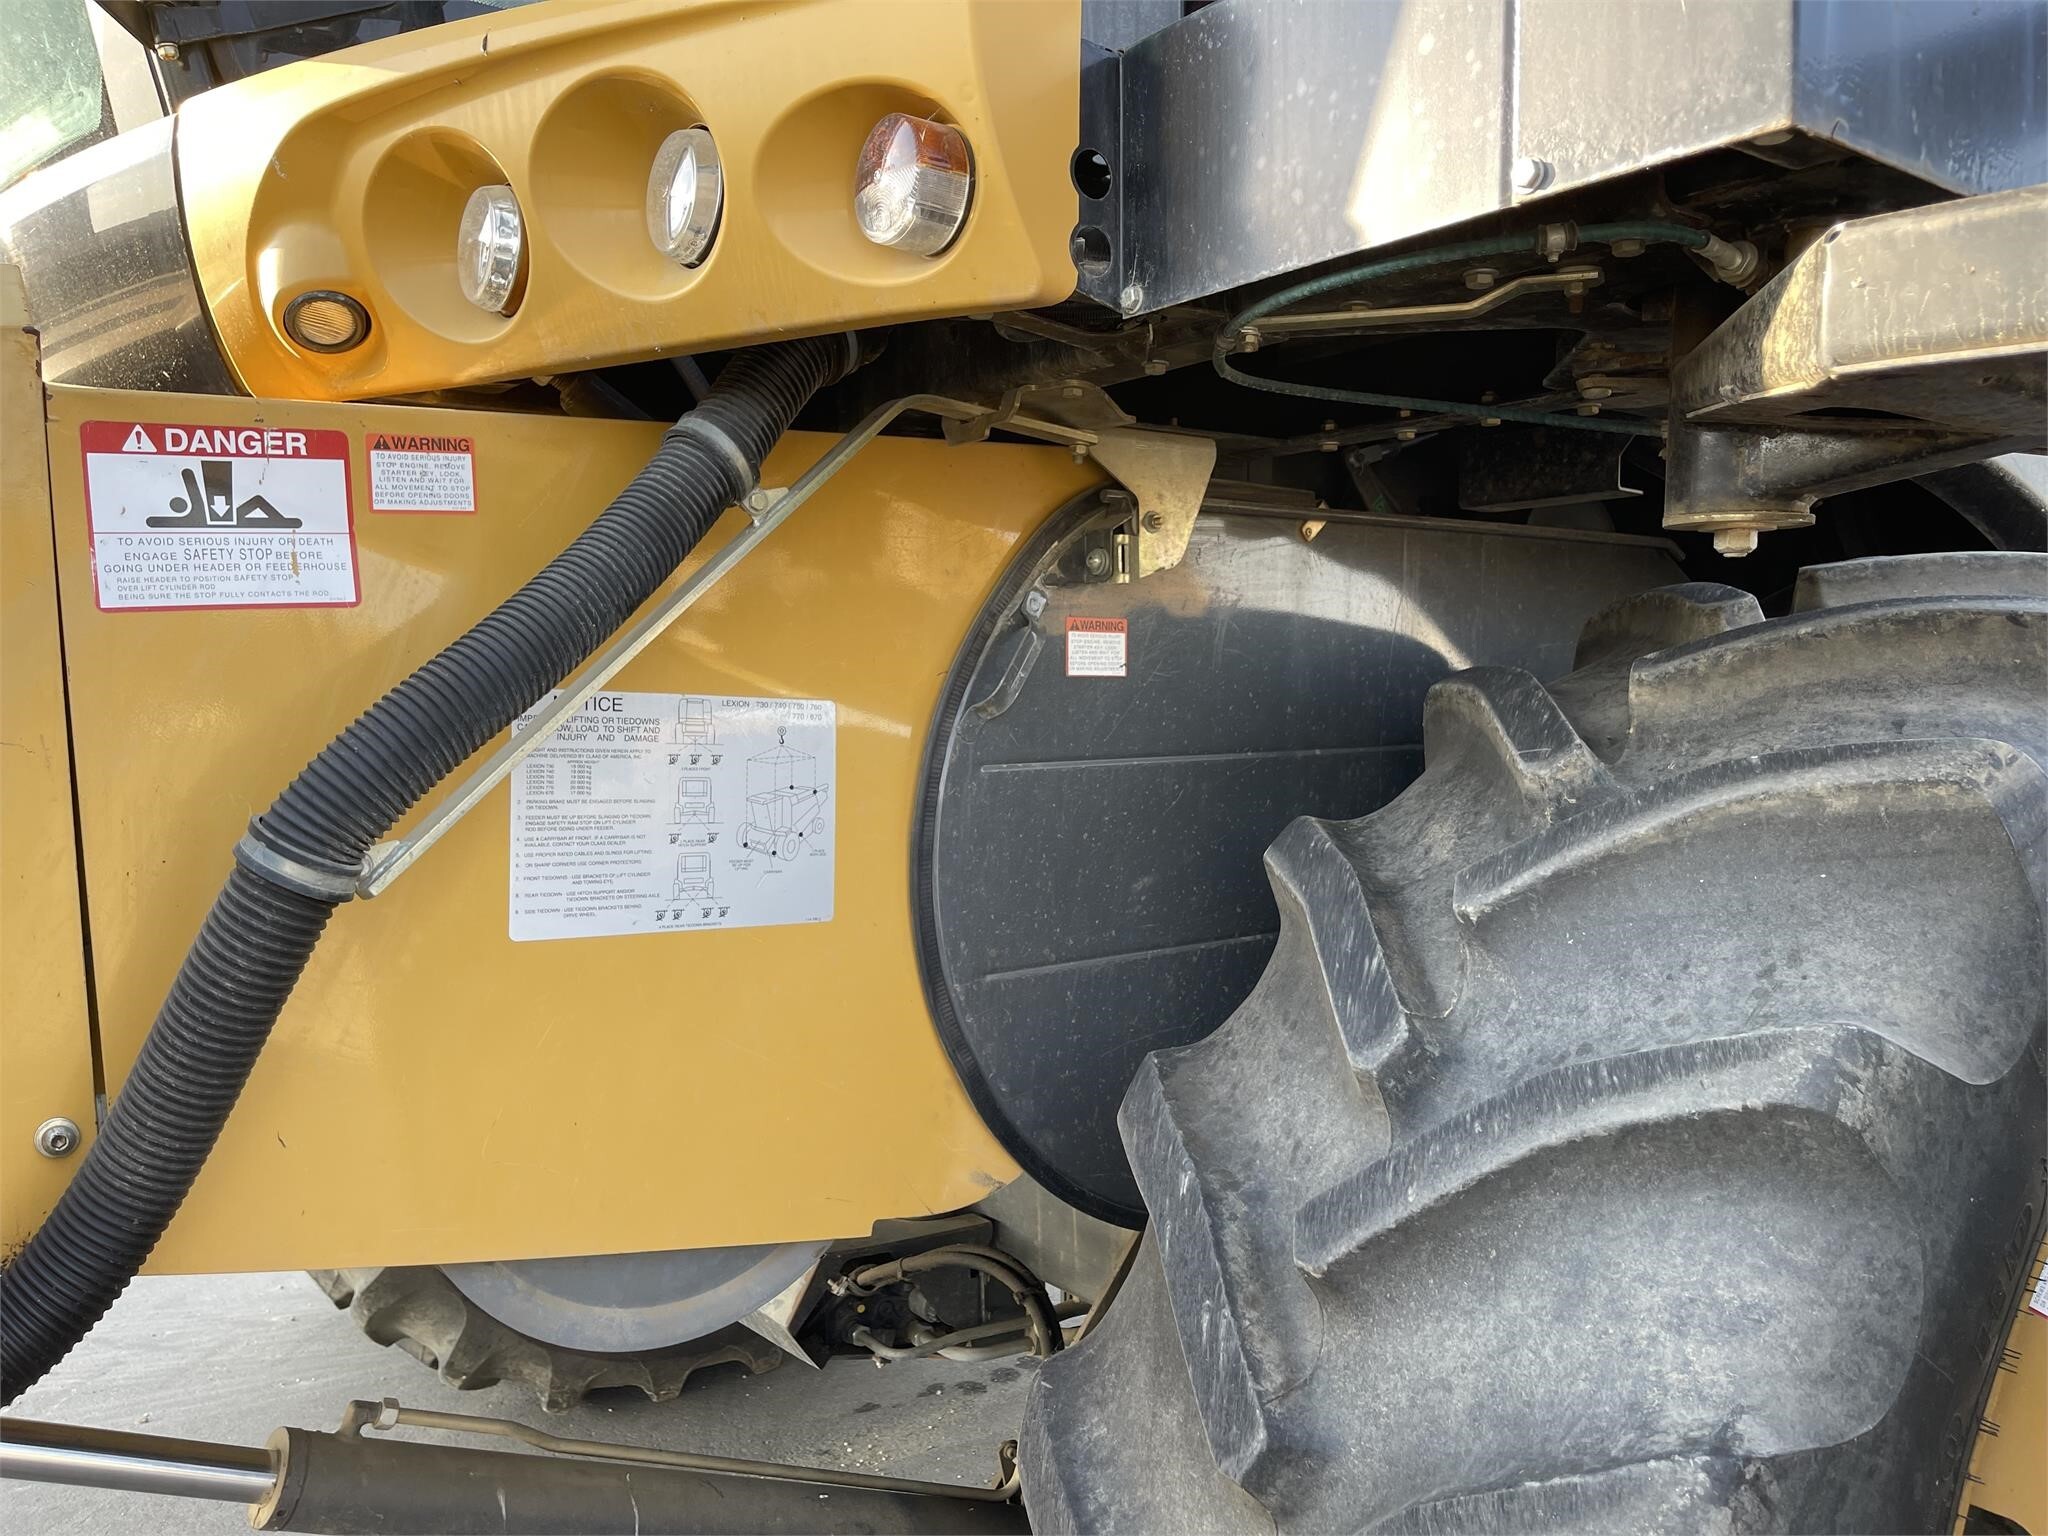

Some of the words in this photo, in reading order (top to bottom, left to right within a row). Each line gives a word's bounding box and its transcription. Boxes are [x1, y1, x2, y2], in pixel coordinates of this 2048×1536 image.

[165, 428, 307, 455] DANGER
[391, 436, 470, 452] WARNING
[376, 452, 386, 460] TO
[434, 462, 465, 470] REMOVE
[117, 537, 133, 546] TO
[138, 537, 174, 546] AVOID
[178, 537, 230, 546] SERIOUS
[234, 537, 274, 546] INJURY
[278, 537, 295, 546] OR
[298, 537, 334, 546] DEATH
[124, 552, 177, 561] ENGAGE
[184, 548, 234, 561] SAFETY
[239, 548, 273, 561] STOP
[275, 551, 322, 560] BEORE
[103, 564, 143, 573] GOING
[147, 564, 189, 573] UNDER
[193, 563, 241, 572] HEADER
[245, 562, 261, 571] OR
[194, 591, 216, 599] STOP
[1080, 620, 1124, 631] WARNING
[567, 715, 599, 724] LIFTING
[601, 716, 614, 724] OR
[615, 717, 660, 726] TIEDOWNS
[603, 725, 615, 733] TO
[643, 726, 660, 734] AND
[556, 733, 587, 741] INJURY
